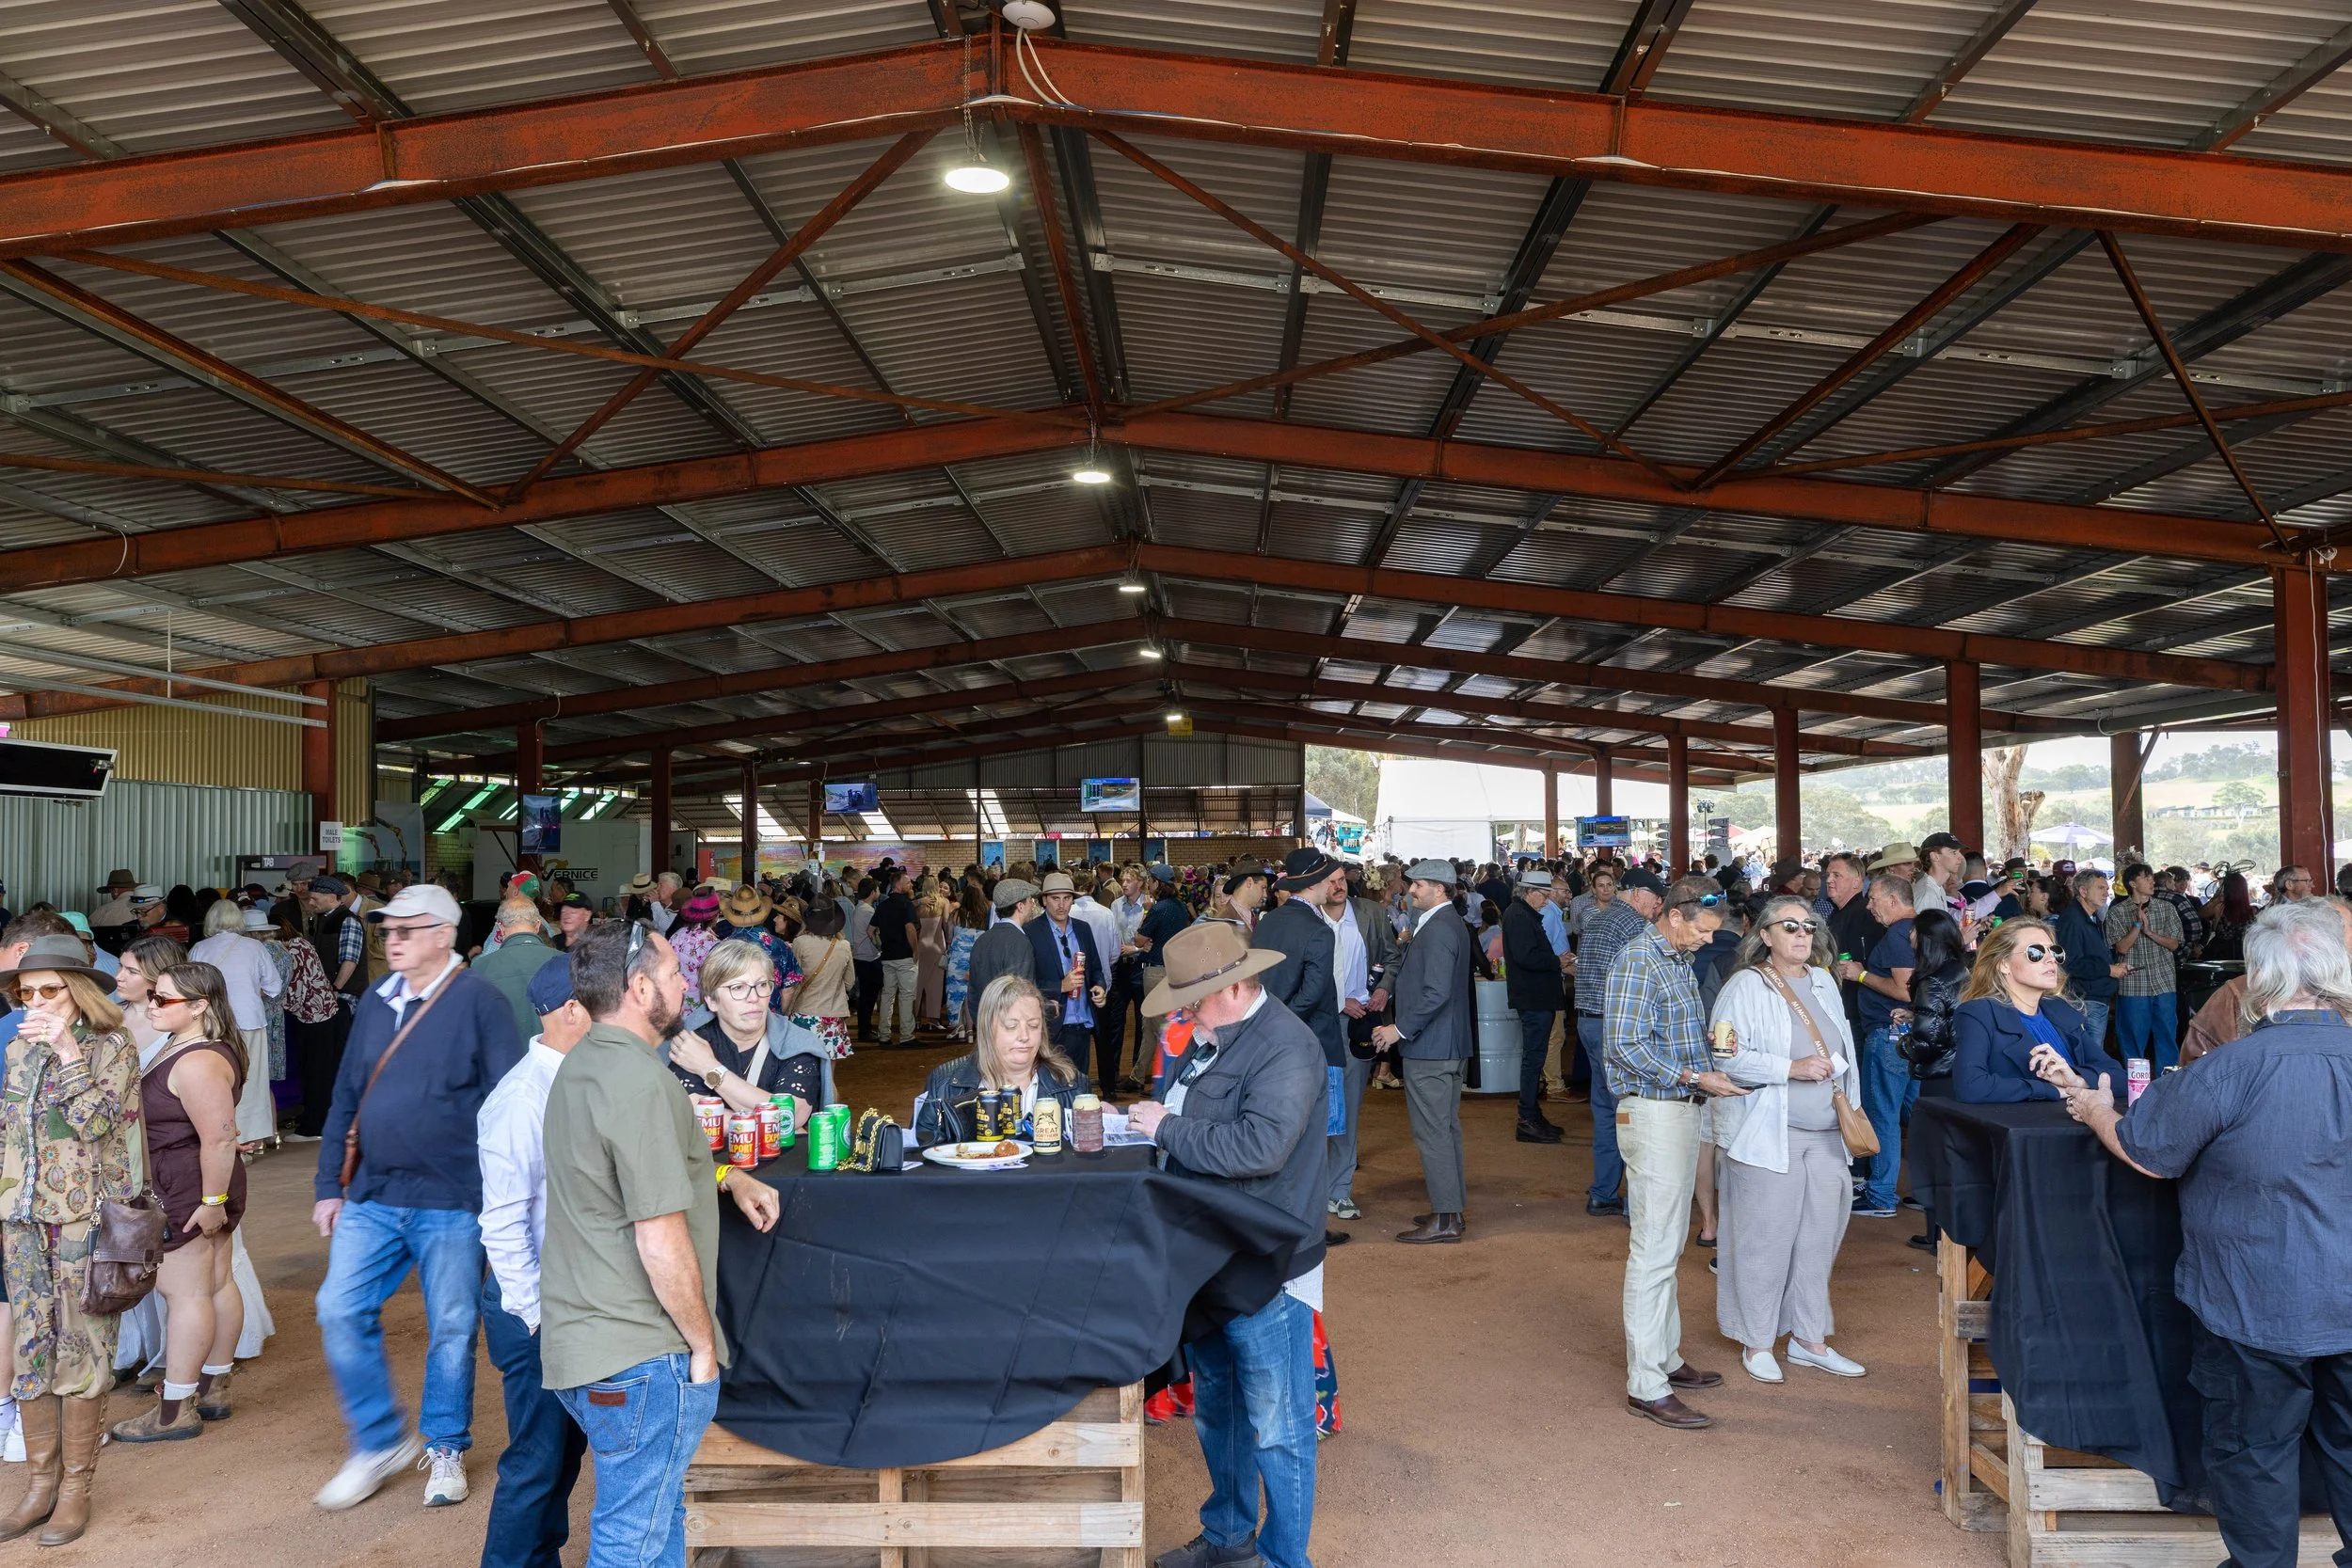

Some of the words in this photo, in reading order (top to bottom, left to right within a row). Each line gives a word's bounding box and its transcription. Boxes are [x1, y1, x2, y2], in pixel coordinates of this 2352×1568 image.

[263, 857, 274, 866] TAB
[542, 868, 598, 881] VERNICE
[1764, 966, 1784, 988] MIMCO
[1791, 1001, 1810, 1025] MIMCO
[1814, 1040, 1827, 1058] MIM
[697, 1117, 721, 1127] MU
[764, 1123, 780, 1133] EM
[728, 1132, 753, 1144] EMU
